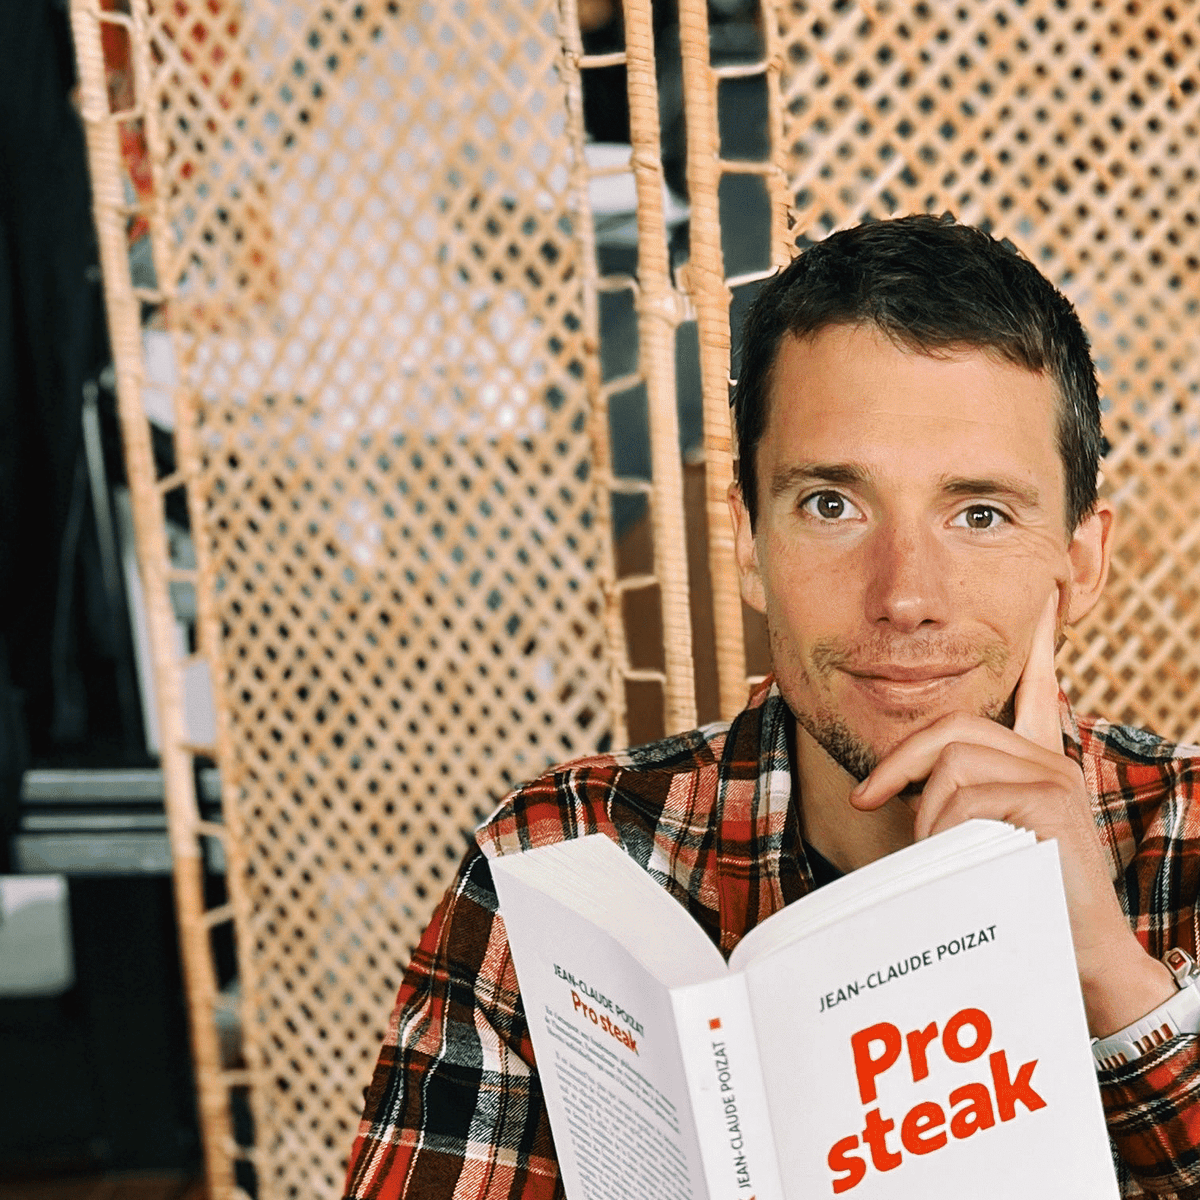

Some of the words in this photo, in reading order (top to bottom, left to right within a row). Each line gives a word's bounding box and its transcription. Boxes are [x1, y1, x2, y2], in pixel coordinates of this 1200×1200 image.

[819, 950, 932, 1013] JEAN-CLAUDE
[937, 925, 998, 961] POIZAT
[571, 989, 598, 1025] Pro
[600, 1014, 640, 1057] steak
[712, 1041, 732, 1092] POIZAT
[851, 1007, 993, 1105] Pro
[723, 1094, 752, 1188] JEAN-CLAUDE
[828, 1049, 1047, 1194] steak
